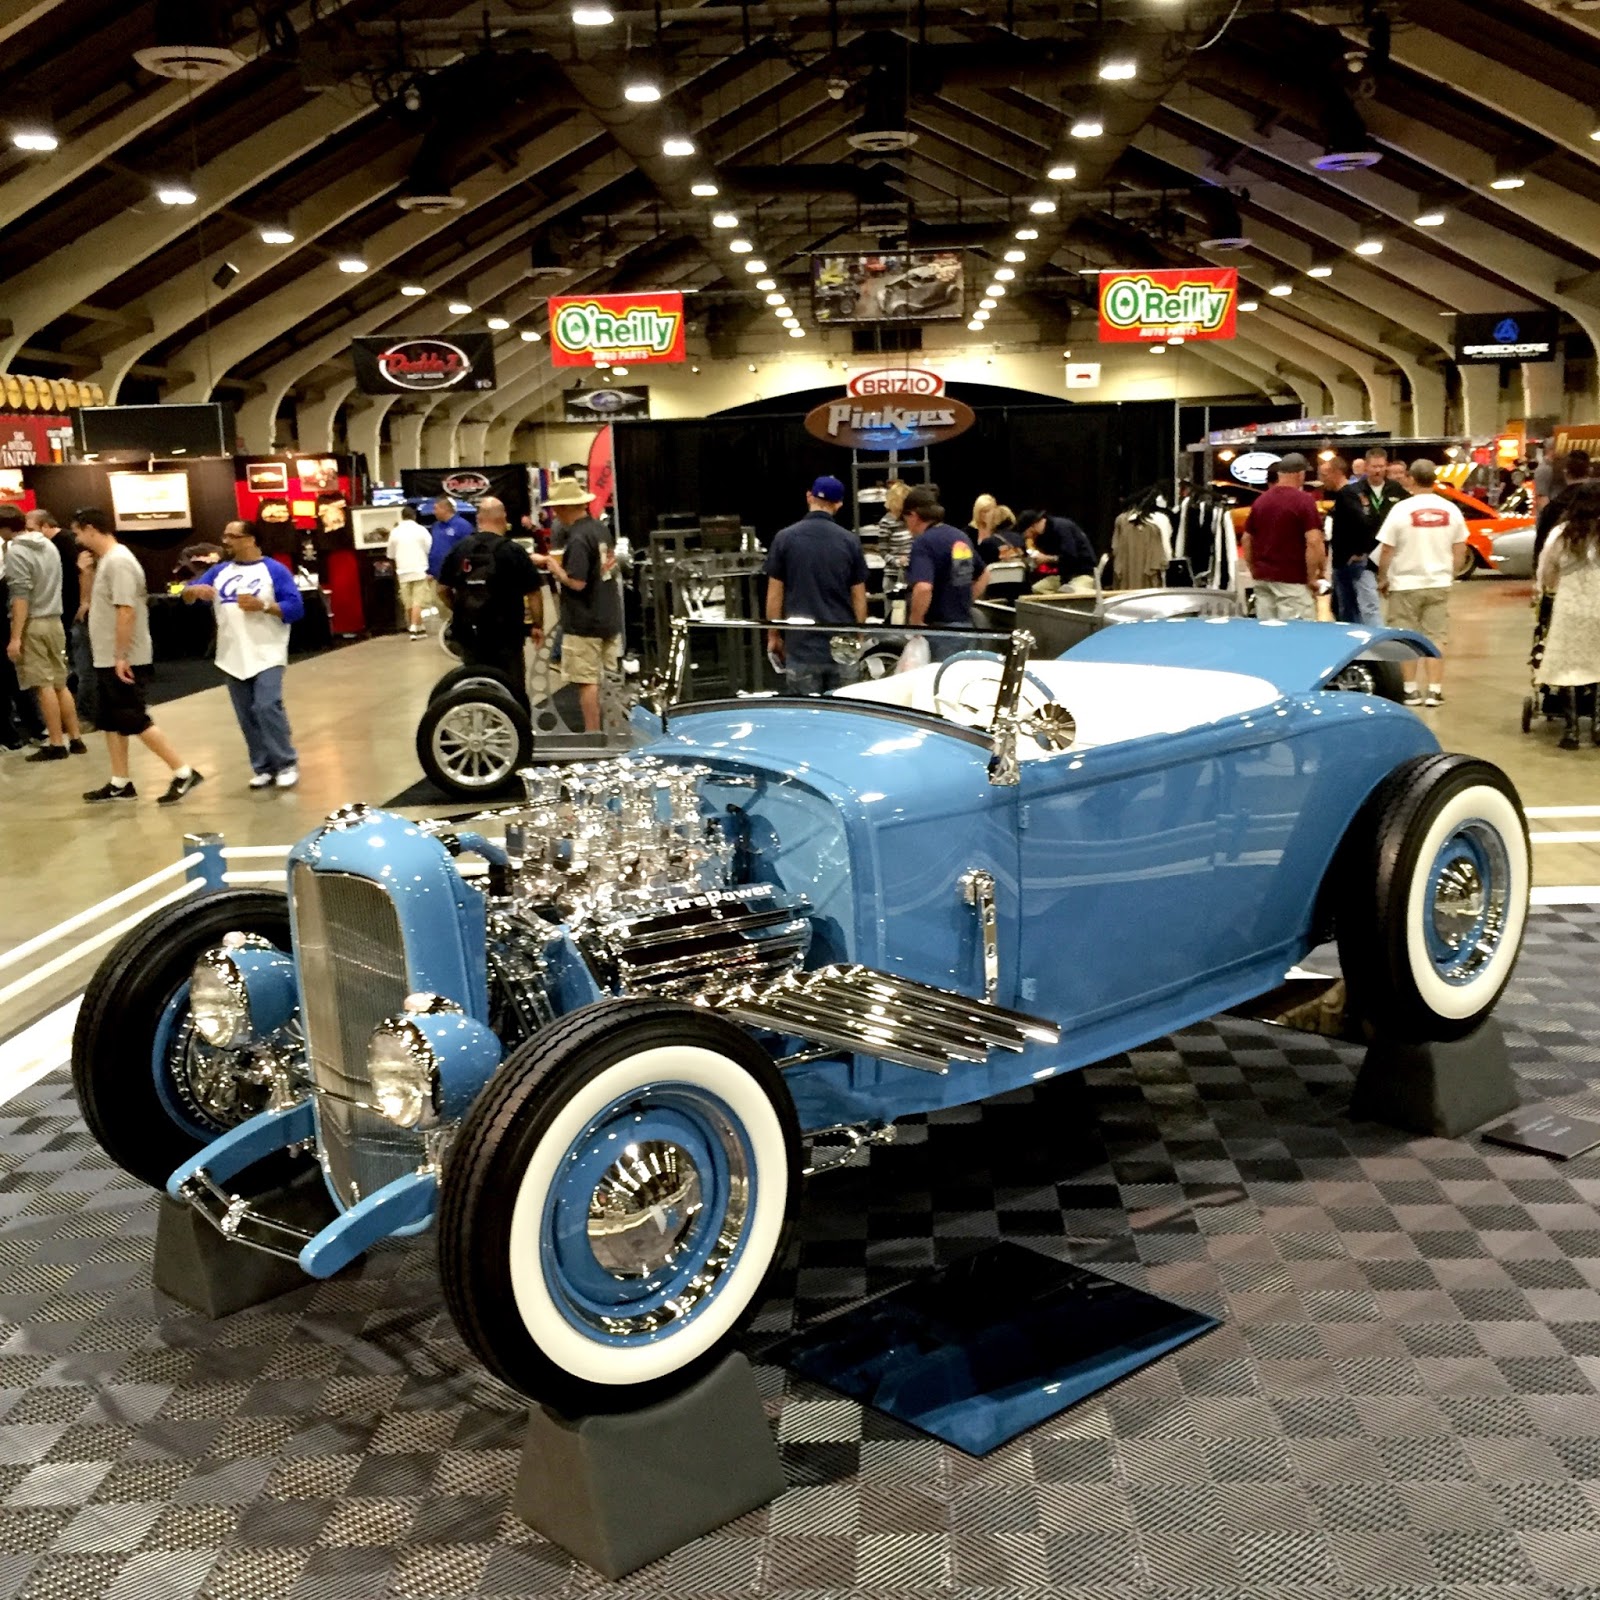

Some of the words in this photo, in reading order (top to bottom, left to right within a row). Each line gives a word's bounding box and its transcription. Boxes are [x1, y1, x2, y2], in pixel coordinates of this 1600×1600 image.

[1107, 282, 1226, 325] O'Reilly
[559, 306, 673, 348] O'Reilly
[1139, 327, 1166, 336] AUTO
[618, 350, 649, 360] PARTS
[862, 378, 930, 394] BRIZIO
